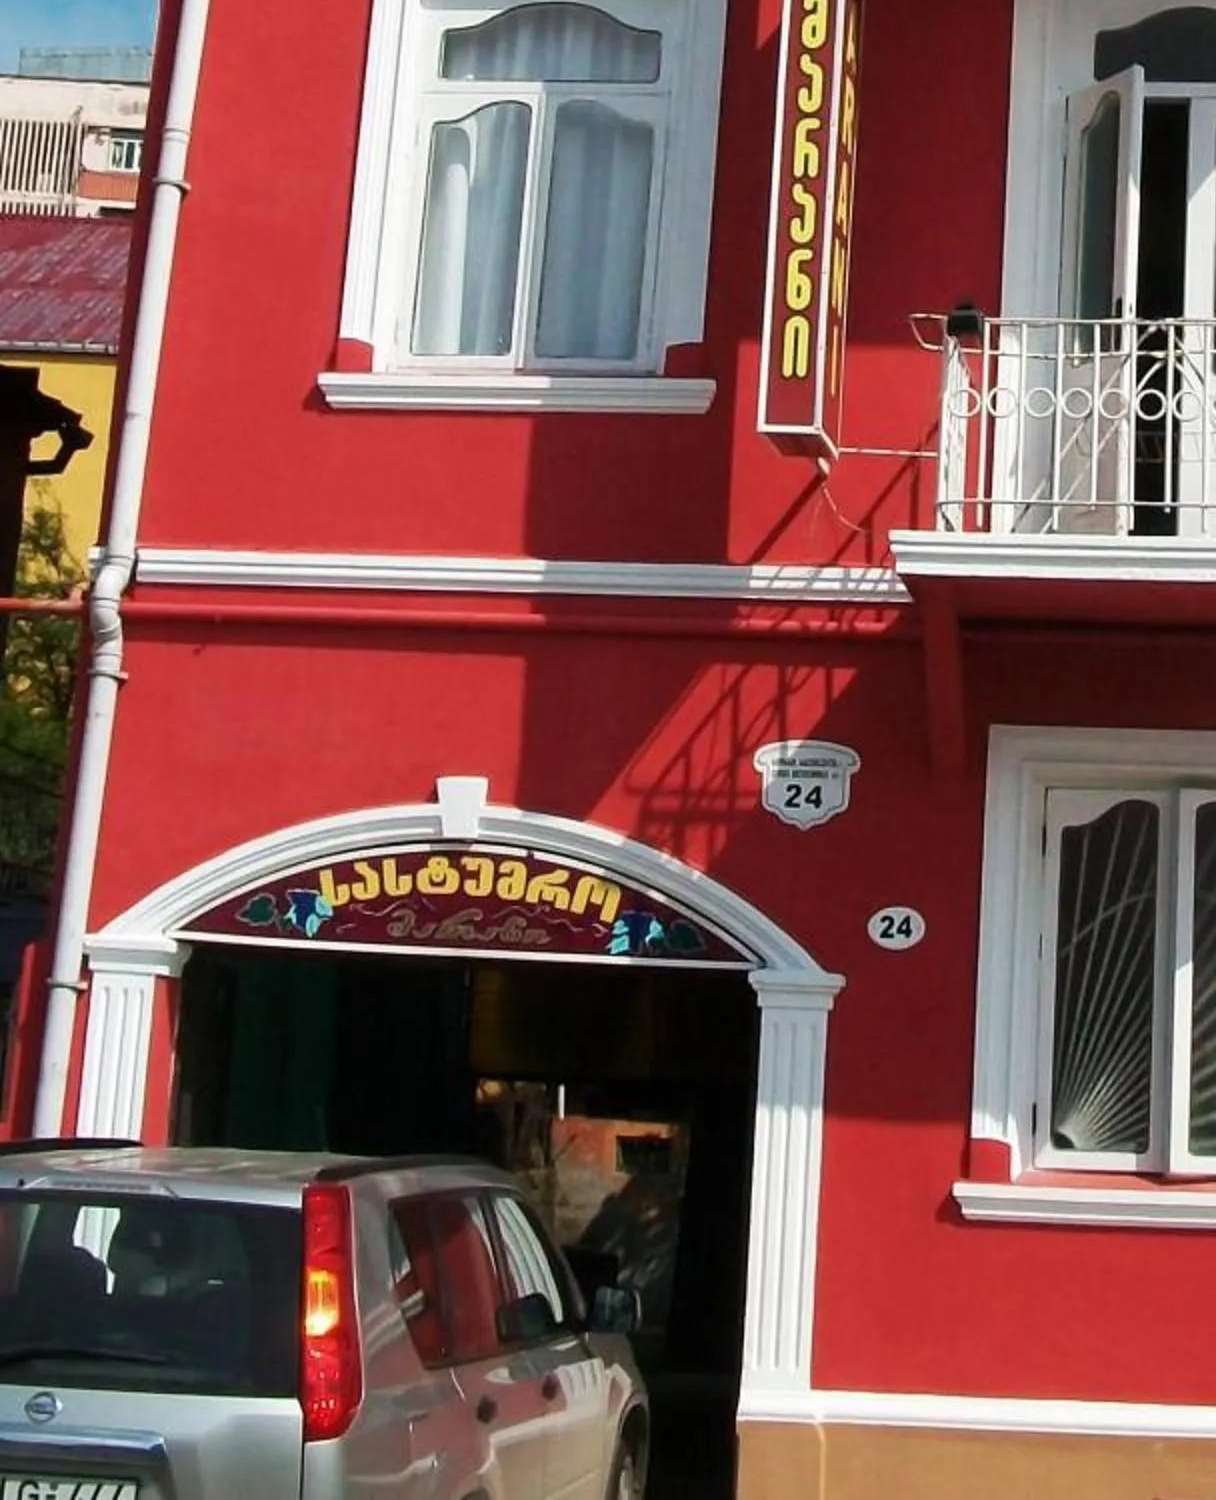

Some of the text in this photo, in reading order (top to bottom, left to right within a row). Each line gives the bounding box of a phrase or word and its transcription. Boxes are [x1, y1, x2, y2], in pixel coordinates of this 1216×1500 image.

[784, 784, 823, 809] 24
[318, 855, 621, 924] სასტუმრო
[880, 915, 913, 940] 24
